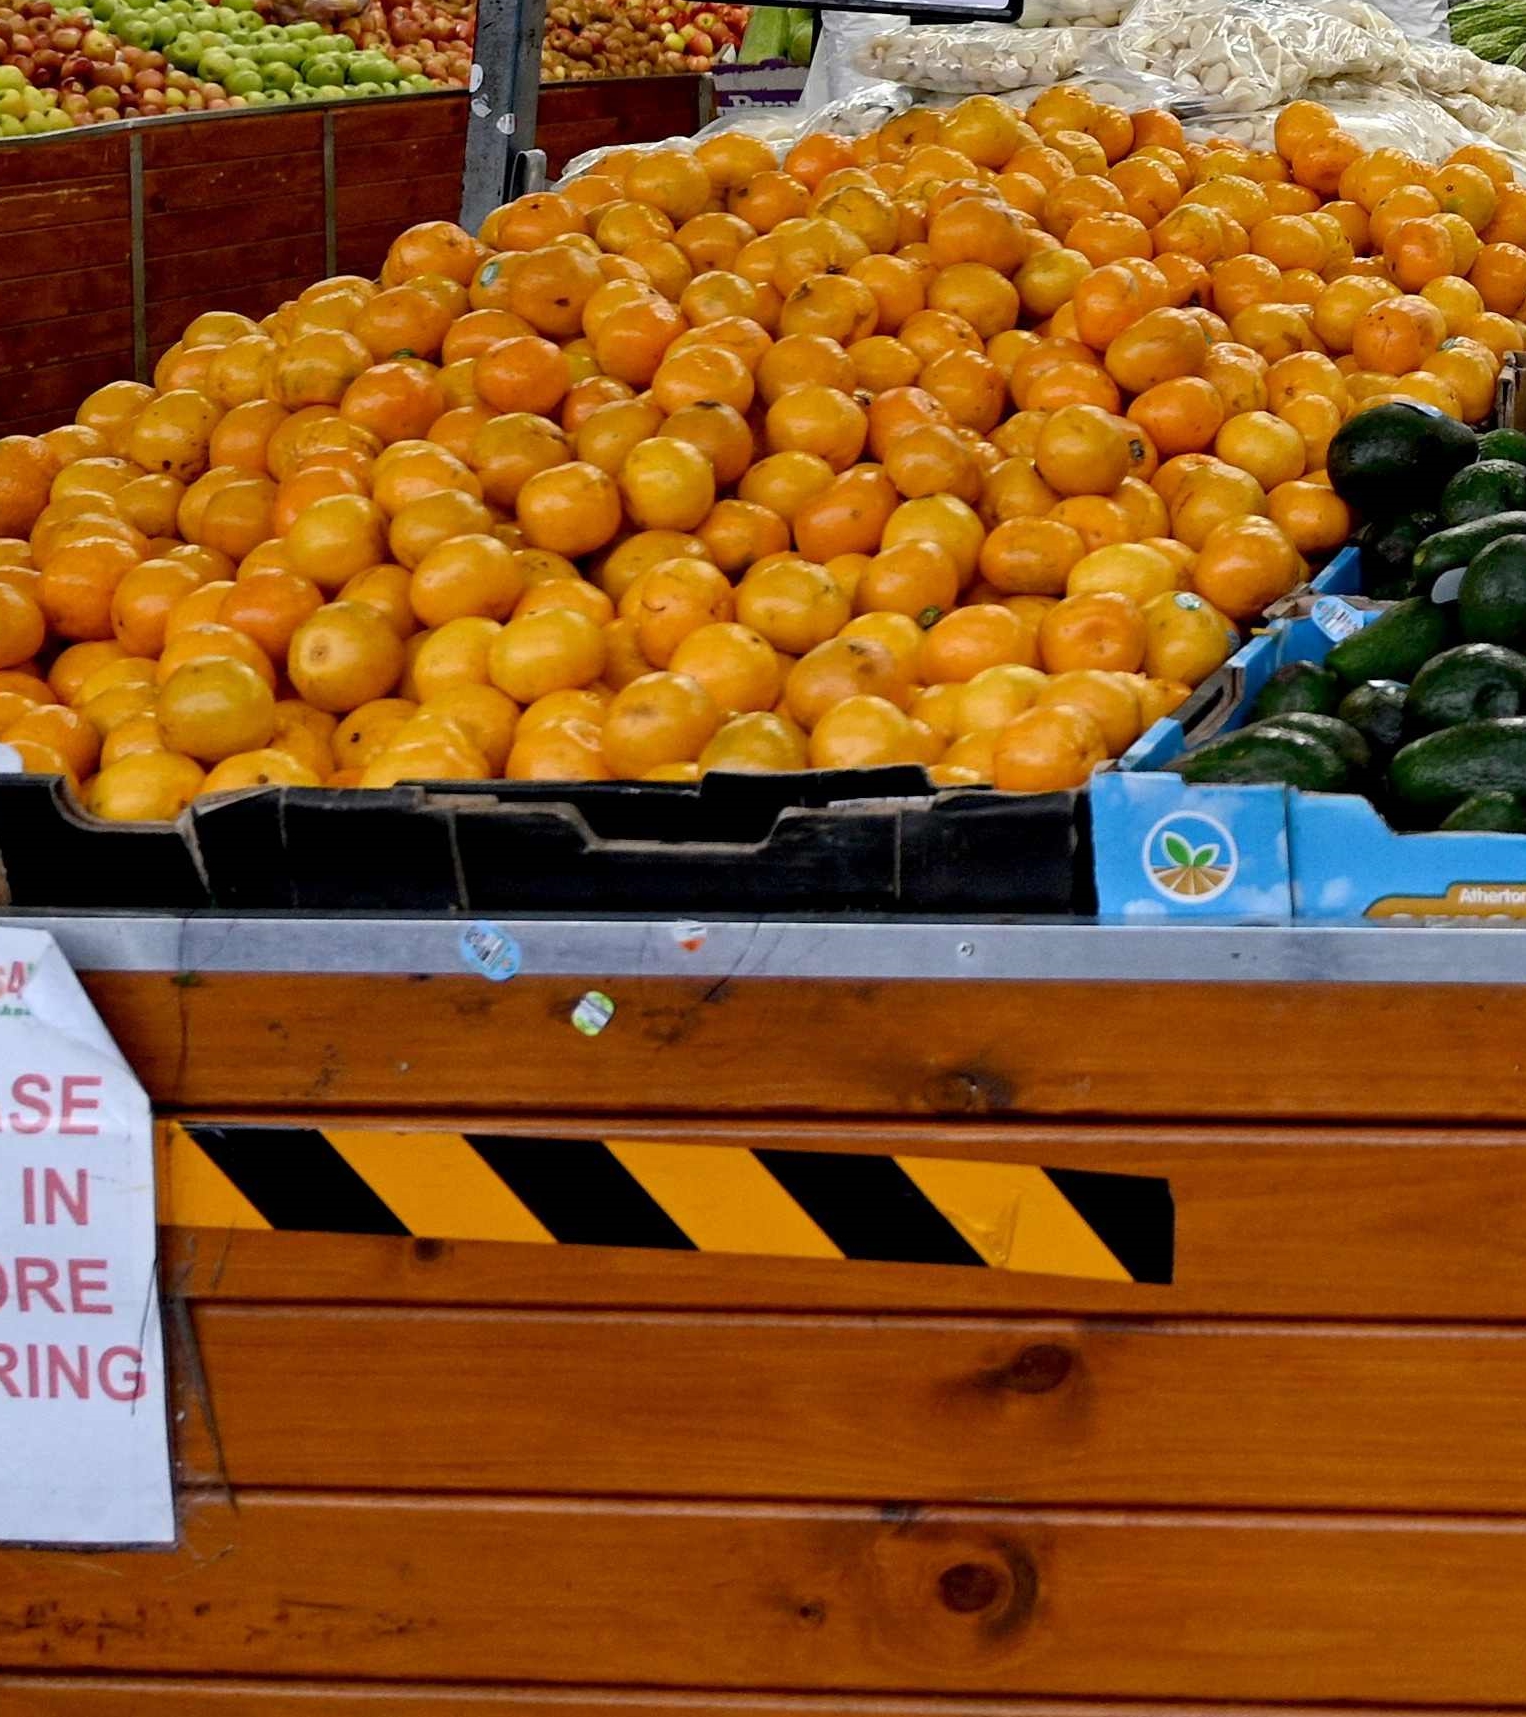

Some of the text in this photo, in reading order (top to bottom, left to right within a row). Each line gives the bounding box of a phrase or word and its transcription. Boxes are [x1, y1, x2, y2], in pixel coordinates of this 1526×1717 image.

[0, 1074, 102, 1135] SE
[23, 1167, 88, 1225] IN
[0, 1257, 113, 1314] RE
